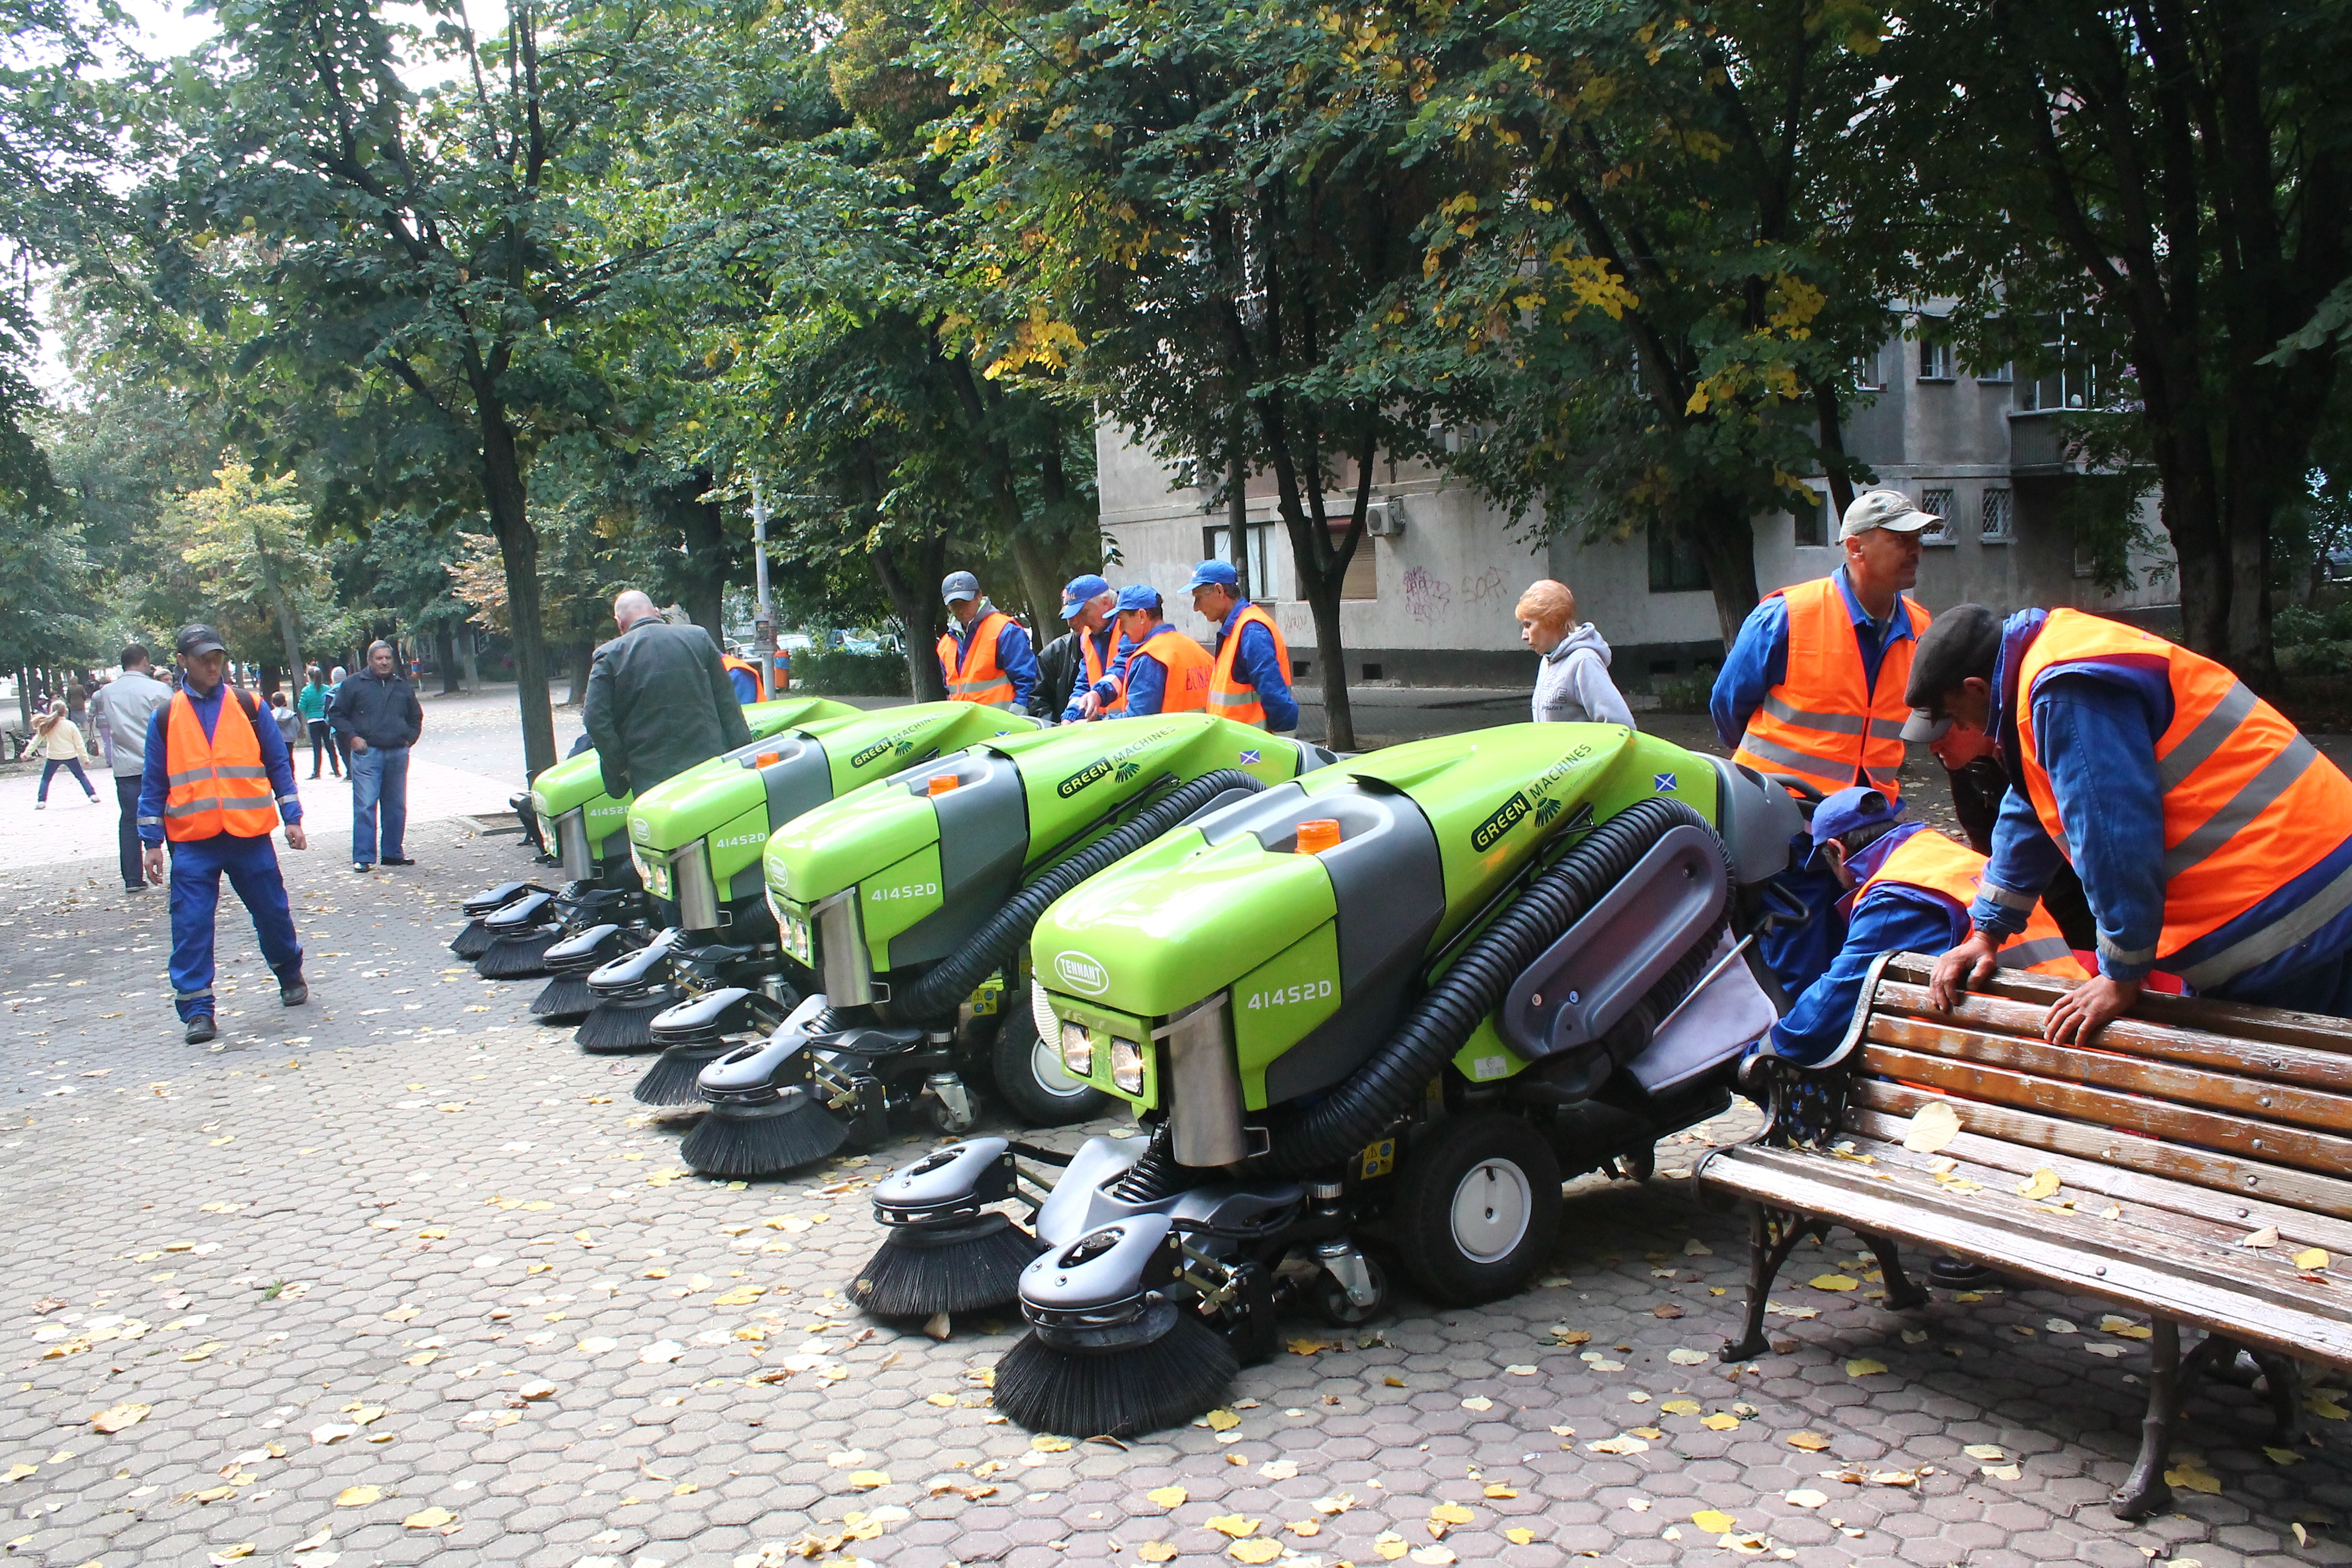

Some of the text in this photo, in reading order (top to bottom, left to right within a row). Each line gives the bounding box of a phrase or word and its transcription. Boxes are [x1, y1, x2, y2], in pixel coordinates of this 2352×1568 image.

[1186, 665, 1210, 690] ECOSA
[854, 740, 890, 766] GREEN
[893, 712, 942, 742] MACHINES
[1061, 726, 1176, 794] GREEN MACHINES
[1477, 744, 1592, 846] GREEN MACHINES
[717, 832, 766, 848] 414S2D
[871, 883, 937, 901] 414S2D
[1060, 958, 1101, 987] TENNANT
[1248, 980, 1332, 1010] 414S2D
